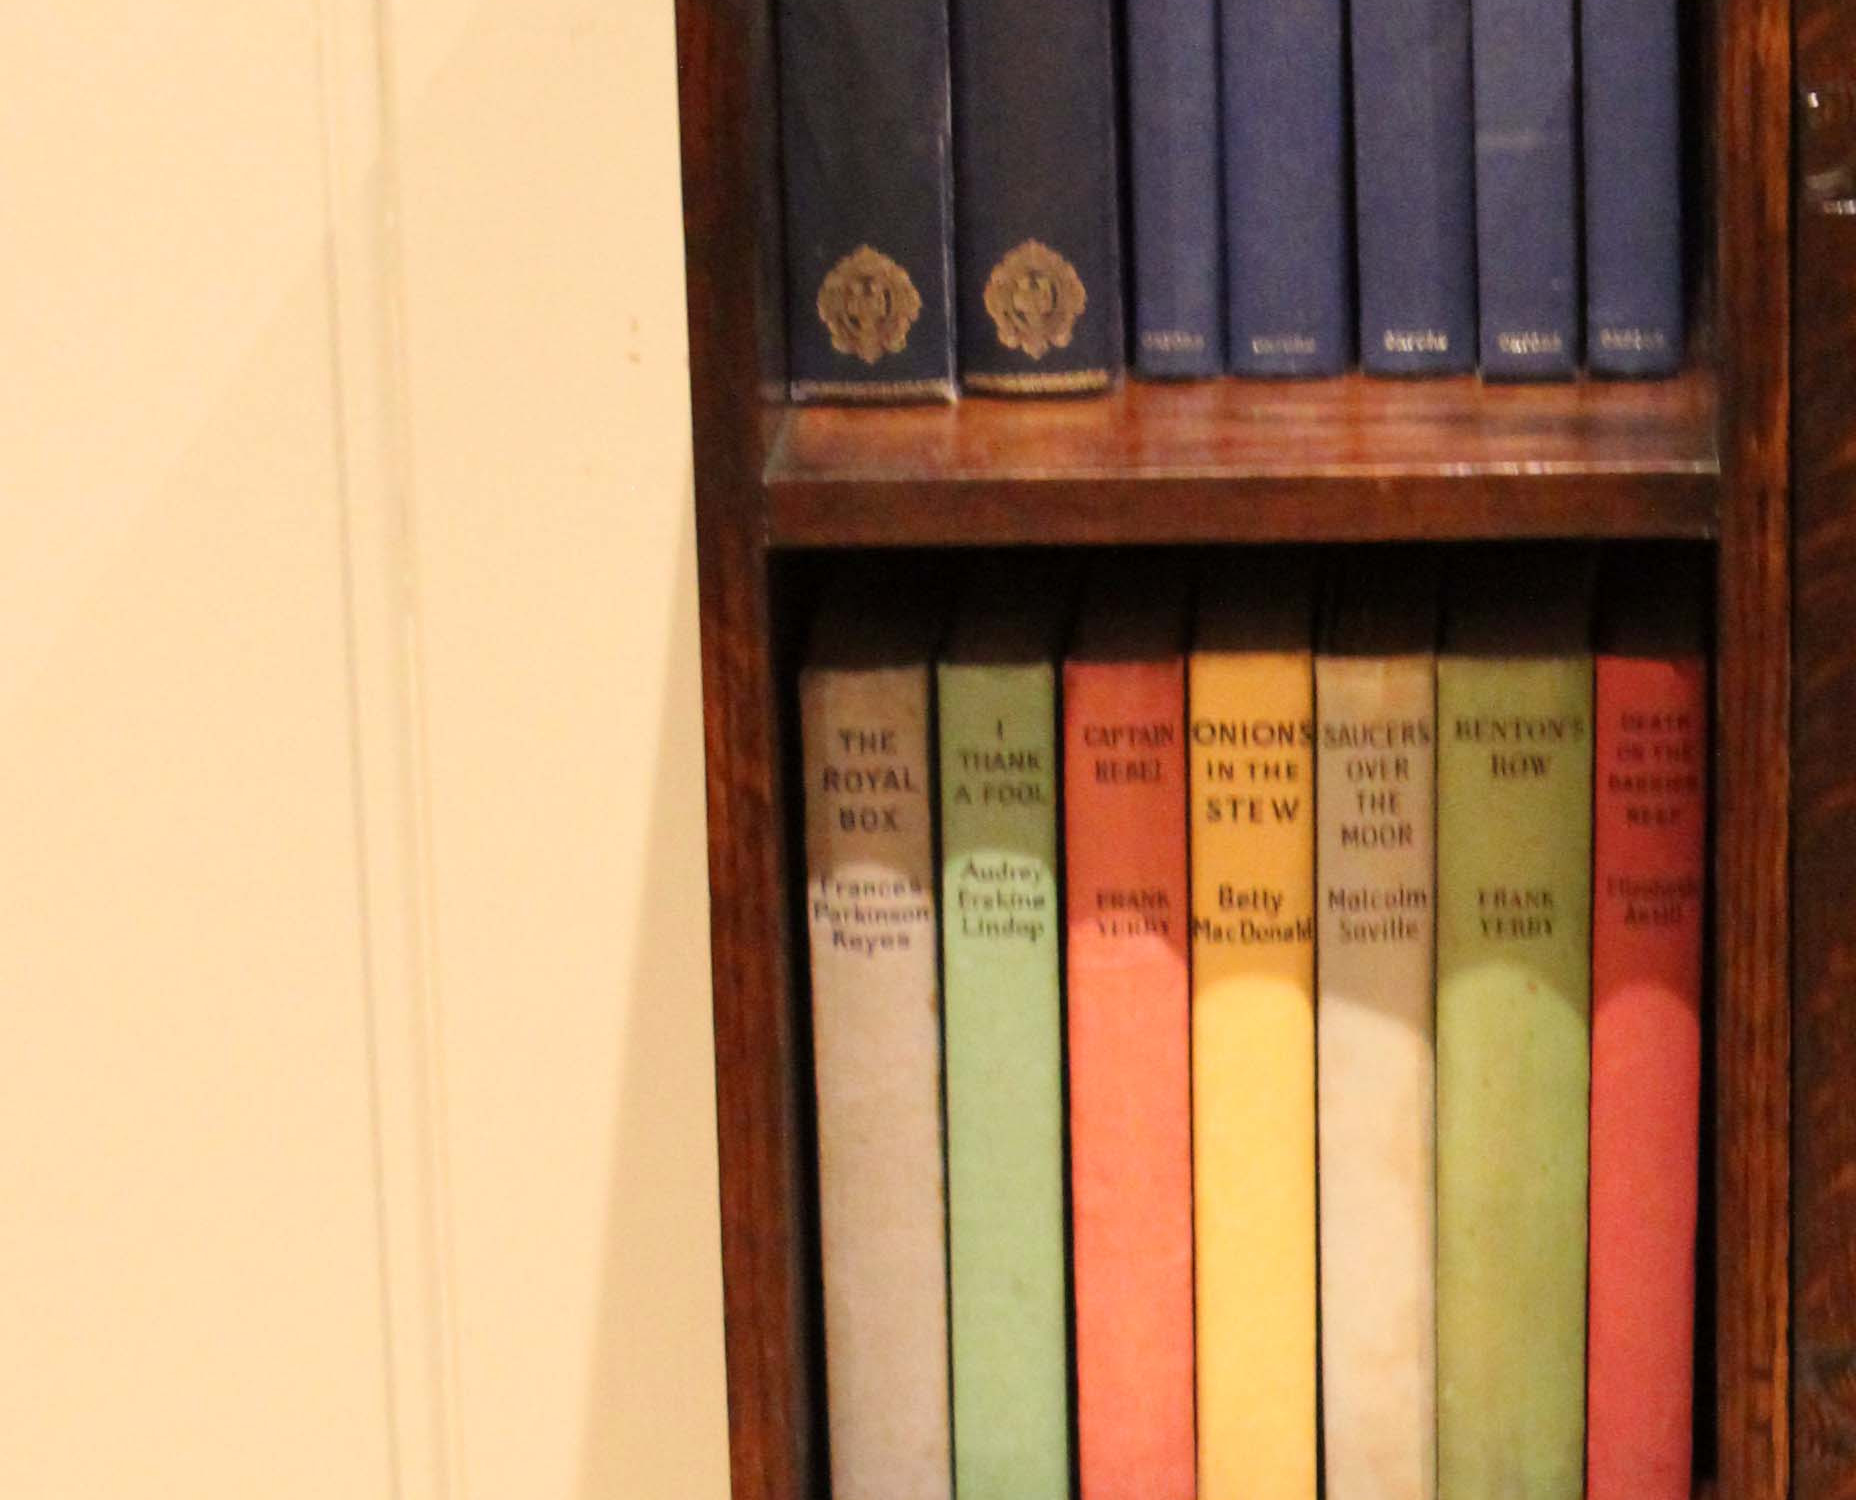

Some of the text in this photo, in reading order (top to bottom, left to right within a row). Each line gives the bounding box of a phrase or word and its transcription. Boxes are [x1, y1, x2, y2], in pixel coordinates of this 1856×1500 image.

[839, 729, 896, 751] THE
[1083, 723, 1173, 747] CAPTAIN
[1193, 719, 1314, 746] ONIONS
[958, 752, 1040, 772] THANK
[1207, 759, 1298, 781] IN THE
[1347, 756, 1409, 783] OVER
[822, 767, 921, 794] ROYAL
[954, 786, 1046, 805] A FOOL
[1356, 792, 1399, 816] THE
[839, 808, 899, 832] BOX
[1206, 796, 1299, 824] STEW
[1340, 823, 1413, 848] MOOR
[962, 857, 1041, 883] Audrey
[1218, 883, 1283, 916] Betty
[814, 902, 929, 924] Parkinson
[1192, 917, 1314, 944] MacDonald
